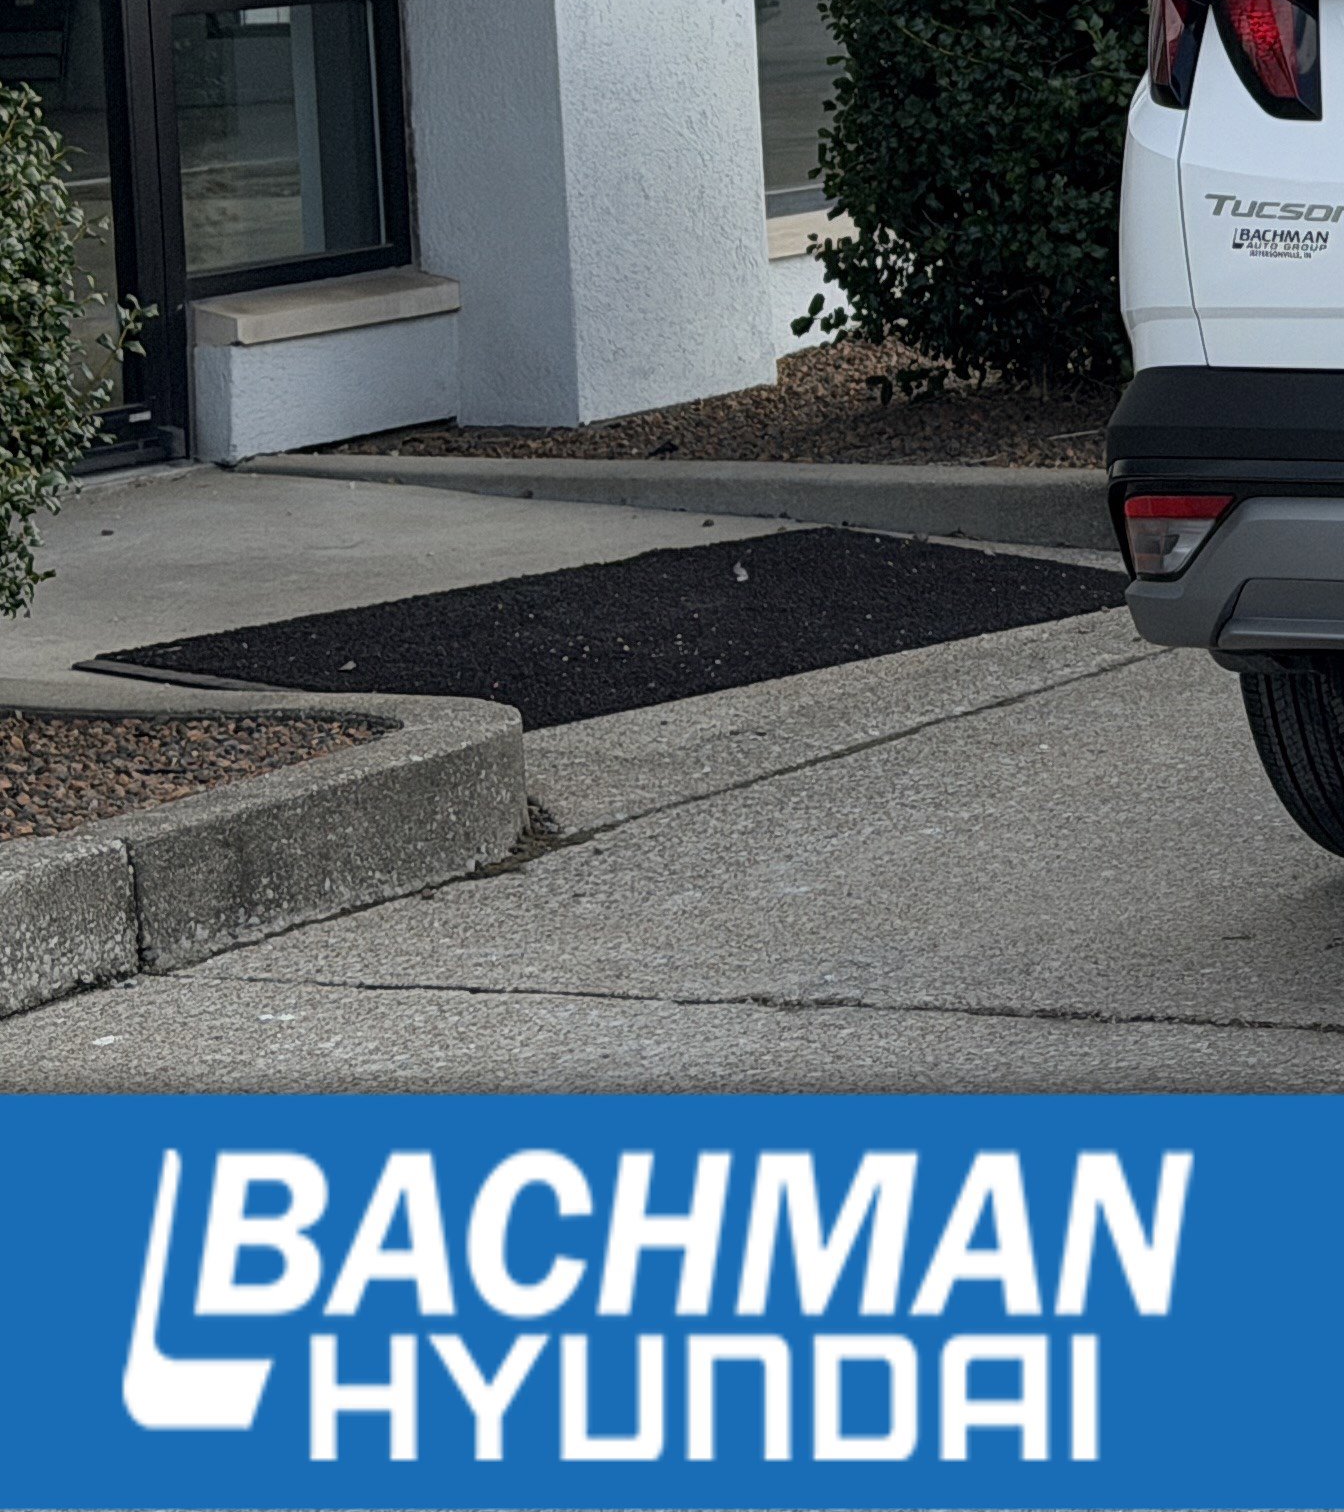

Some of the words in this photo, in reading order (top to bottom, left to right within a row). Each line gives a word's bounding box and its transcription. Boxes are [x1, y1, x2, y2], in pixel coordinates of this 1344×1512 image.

[1240, 228, 1329, 244] BACHMAN
[1246, 242, 1279, 250] AUTO
[1283, 243, 1328, 252] GROUP
